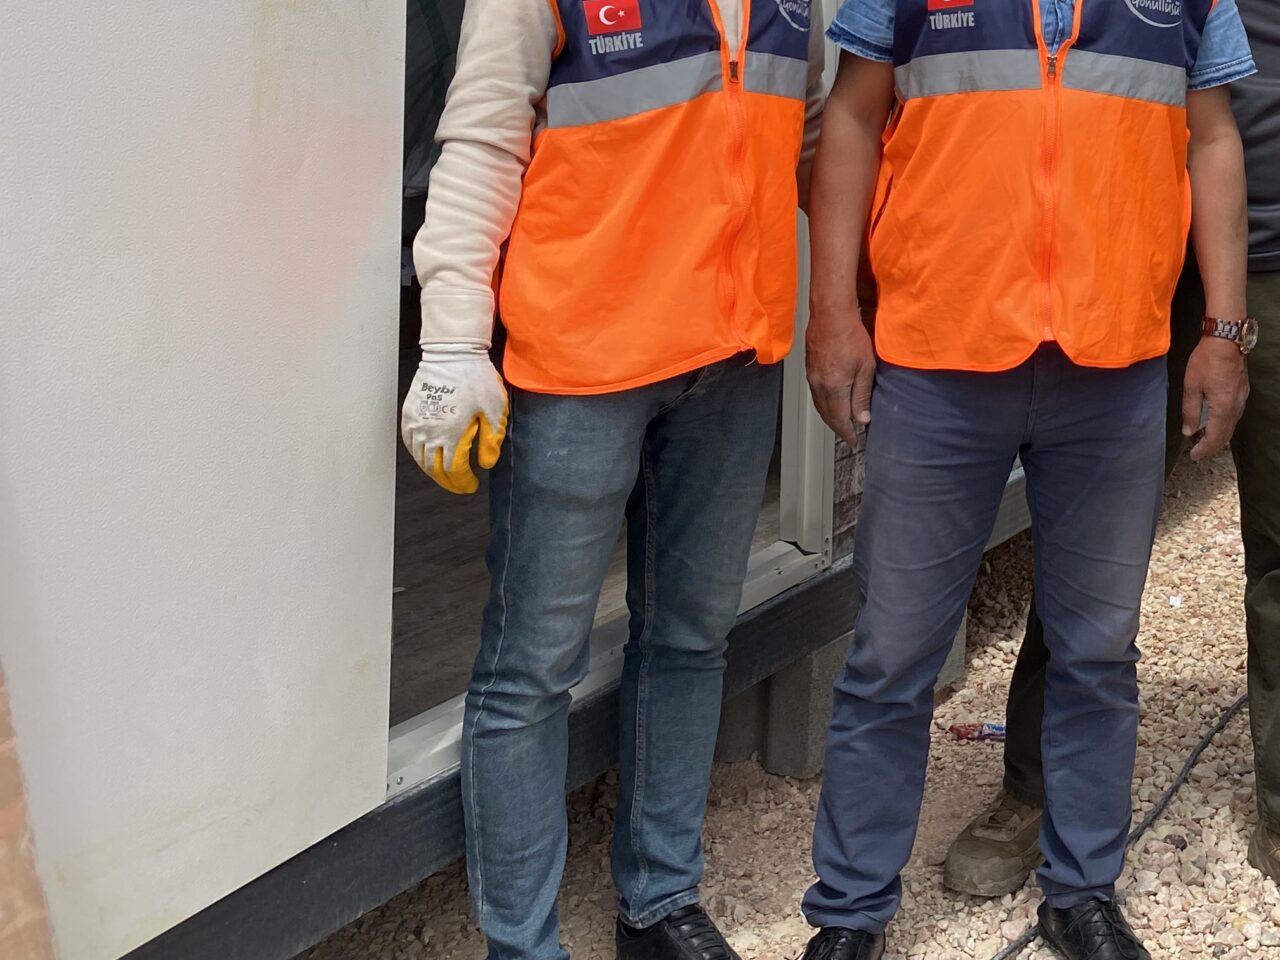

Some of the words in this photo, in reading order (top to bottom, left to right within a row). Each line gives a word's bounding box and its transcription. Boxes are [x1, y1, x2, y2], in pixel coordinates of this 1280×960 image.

[929, 10, 975, 30] TÜRKİYE
[588, 31, 643, 55] TÜRKİYE
[420, 382, 456, 394] Beybi
